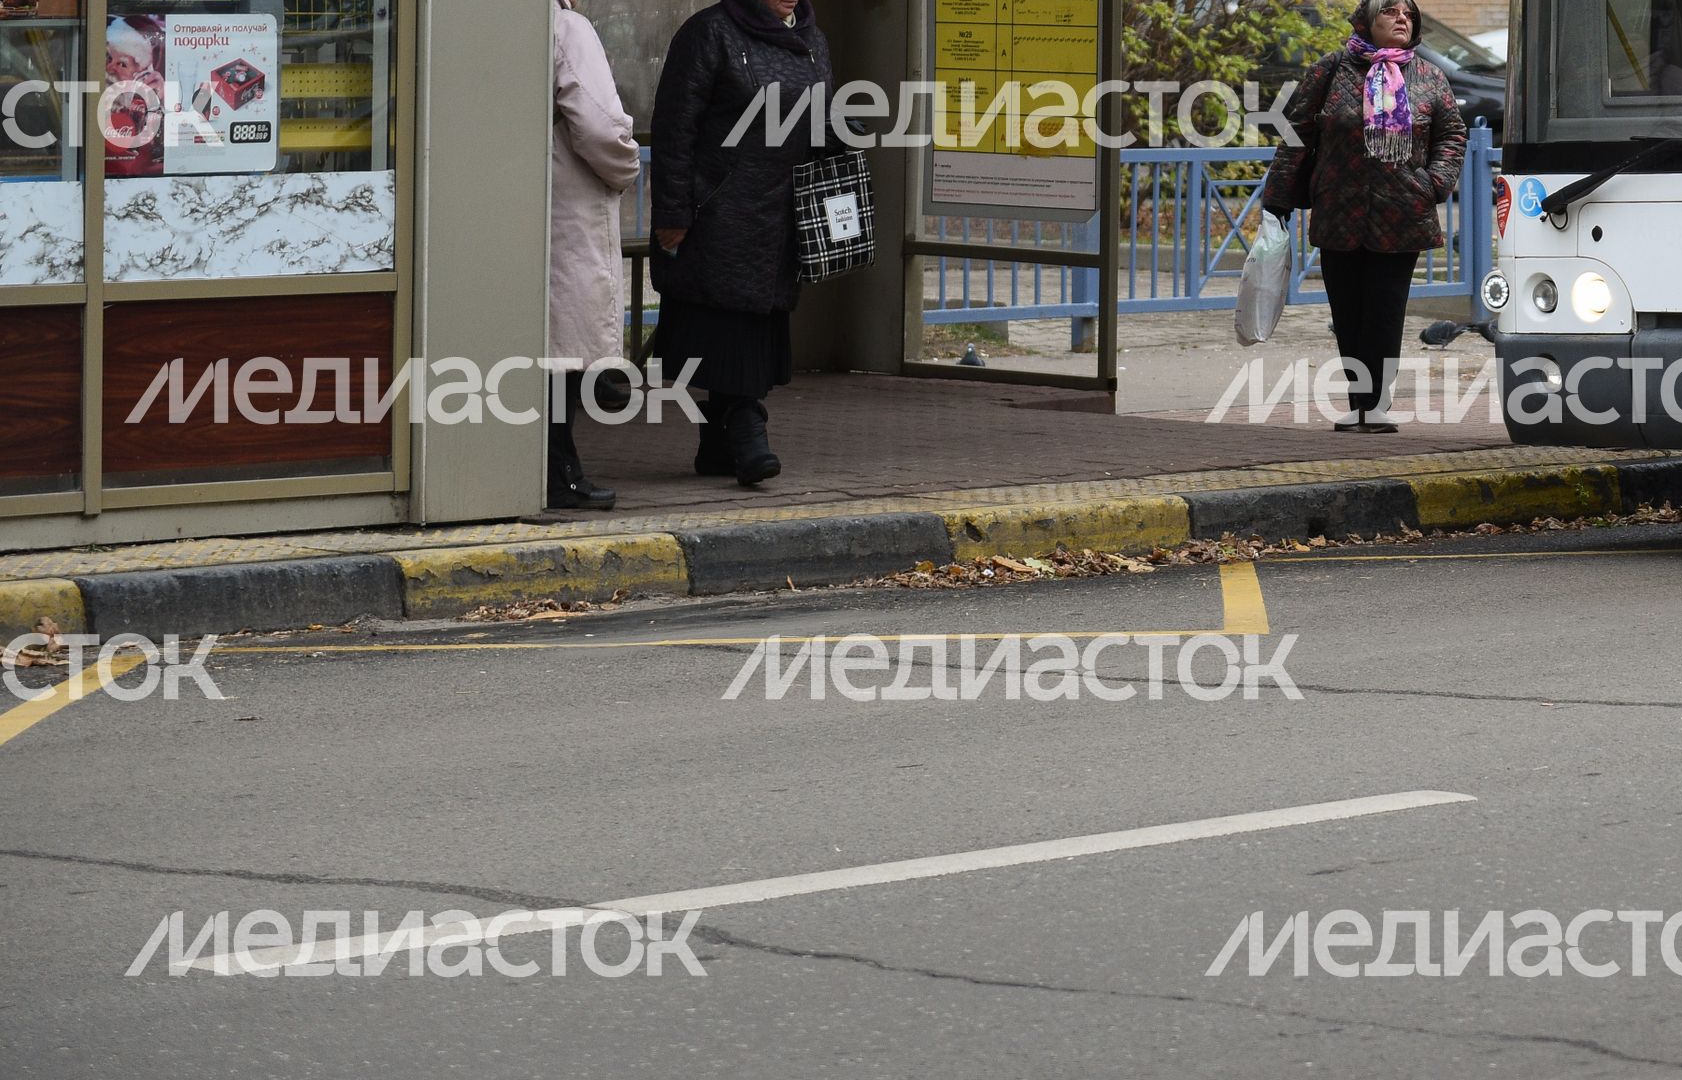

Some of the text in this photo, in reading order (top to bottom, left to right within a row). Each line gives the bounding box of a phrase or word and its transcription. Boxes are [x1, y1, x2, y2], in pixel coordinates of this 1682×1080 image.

[174, 23, 223, 34] Отправляй
[232, 23, 268, 34] получай
[174, 33, 230, 49] подарки
